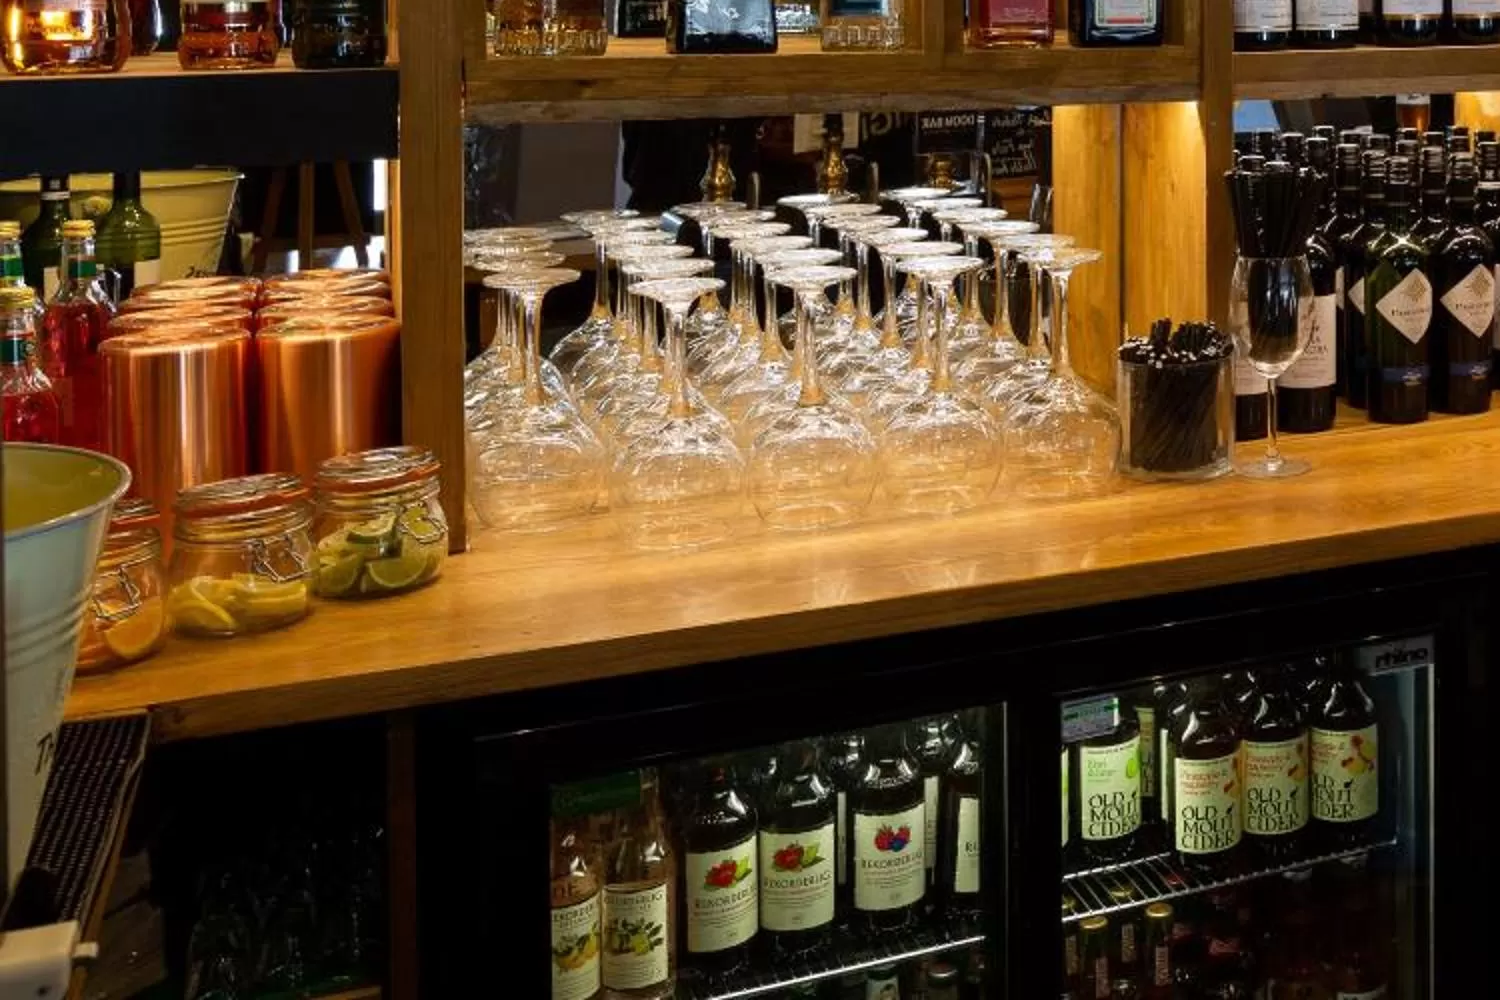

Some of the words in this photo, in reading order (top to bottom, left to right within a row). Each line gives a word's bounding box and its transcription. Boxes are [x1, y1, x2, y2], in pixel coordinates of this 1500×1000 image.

[1375, 647, 1428, 668] rhino
[1313, 775, 1334, 791] LD
[1089, 791, 1125, 809] OLD
[1247, 787, 1282, 804] OLD
[1182, 805, 1218, 821] OLD
[1247, 799, 1297, 816] MOUT
[1314, 803, 1354, 819] IDER
[1088, 814, 1138, 837] CIDER
[1183, 814, 1233, 835] MOUT
[1247, 812, 1300, 832] CIDER
[1182, 830, 1235, 850] CIDER
